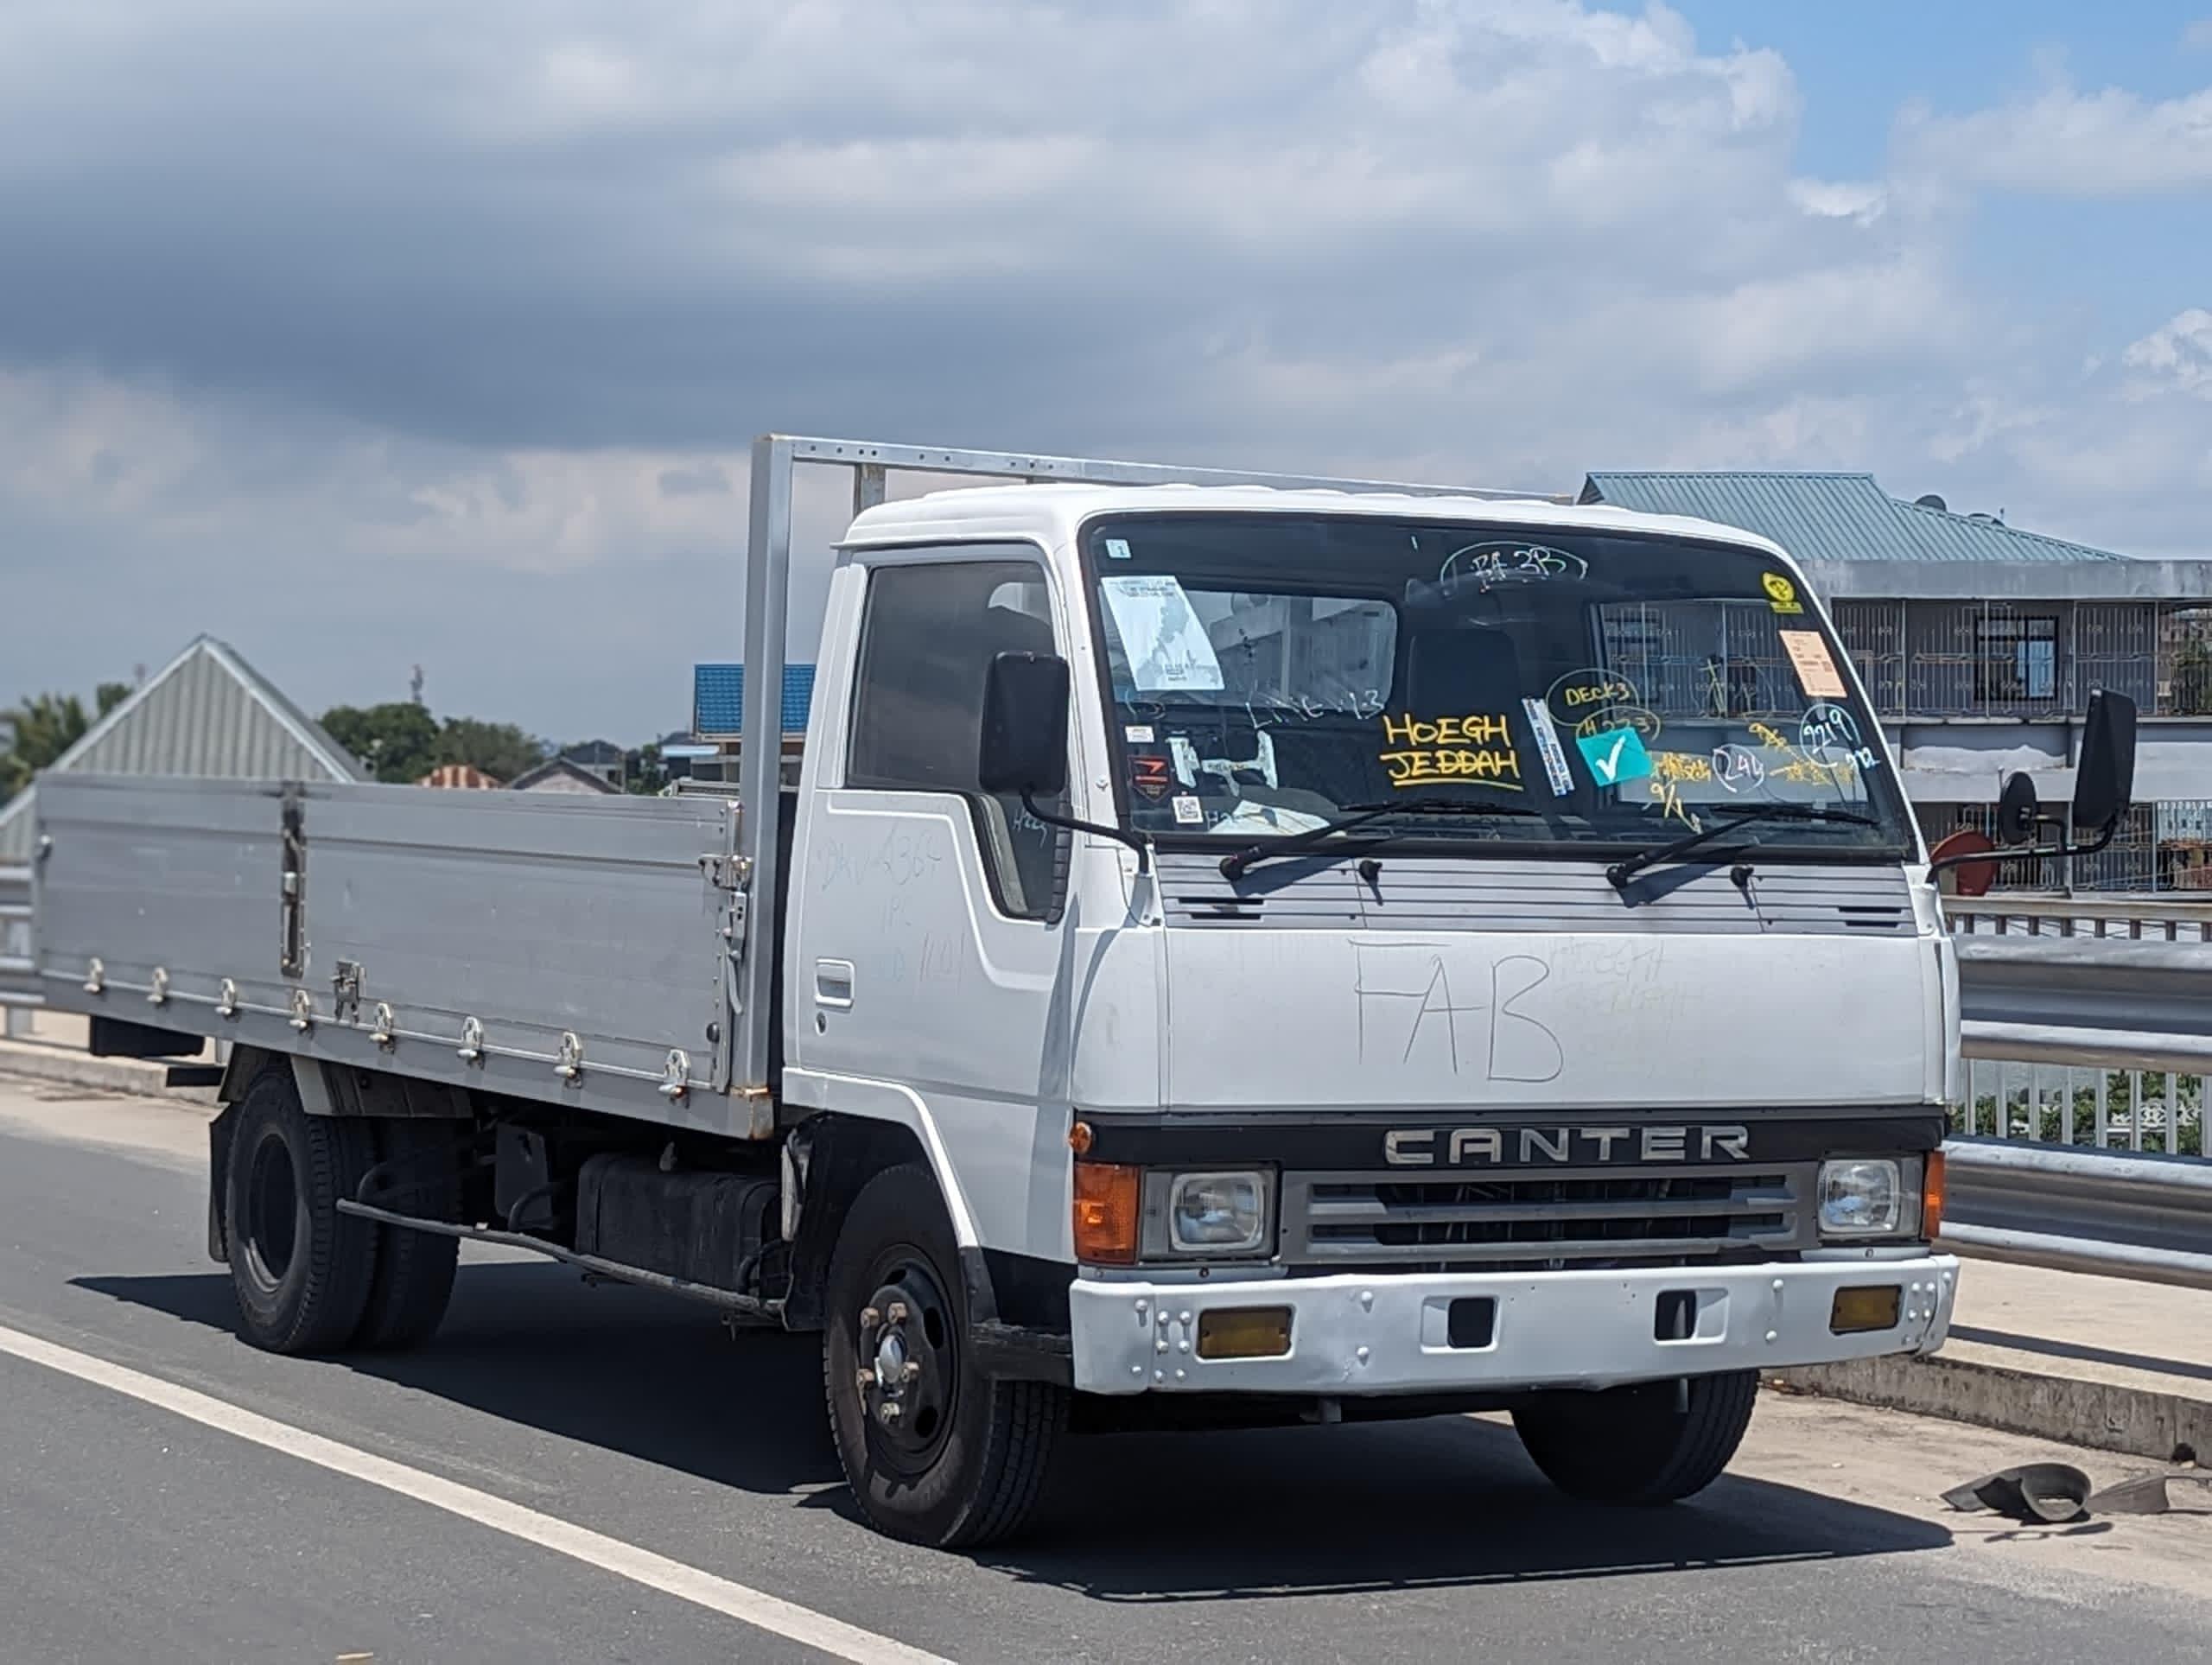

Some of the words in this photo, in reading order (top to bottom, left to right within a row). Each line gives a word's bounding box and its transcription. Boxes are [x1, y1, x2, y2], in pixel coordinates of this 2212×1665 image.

[1382, 713, 1511, 747] HOEGH
[1379, 749, 1522, 778] JEDDAH
[1347, 937, 1564, 1083] FAB
[1384, 1125, 1751, 1166] CANTER
